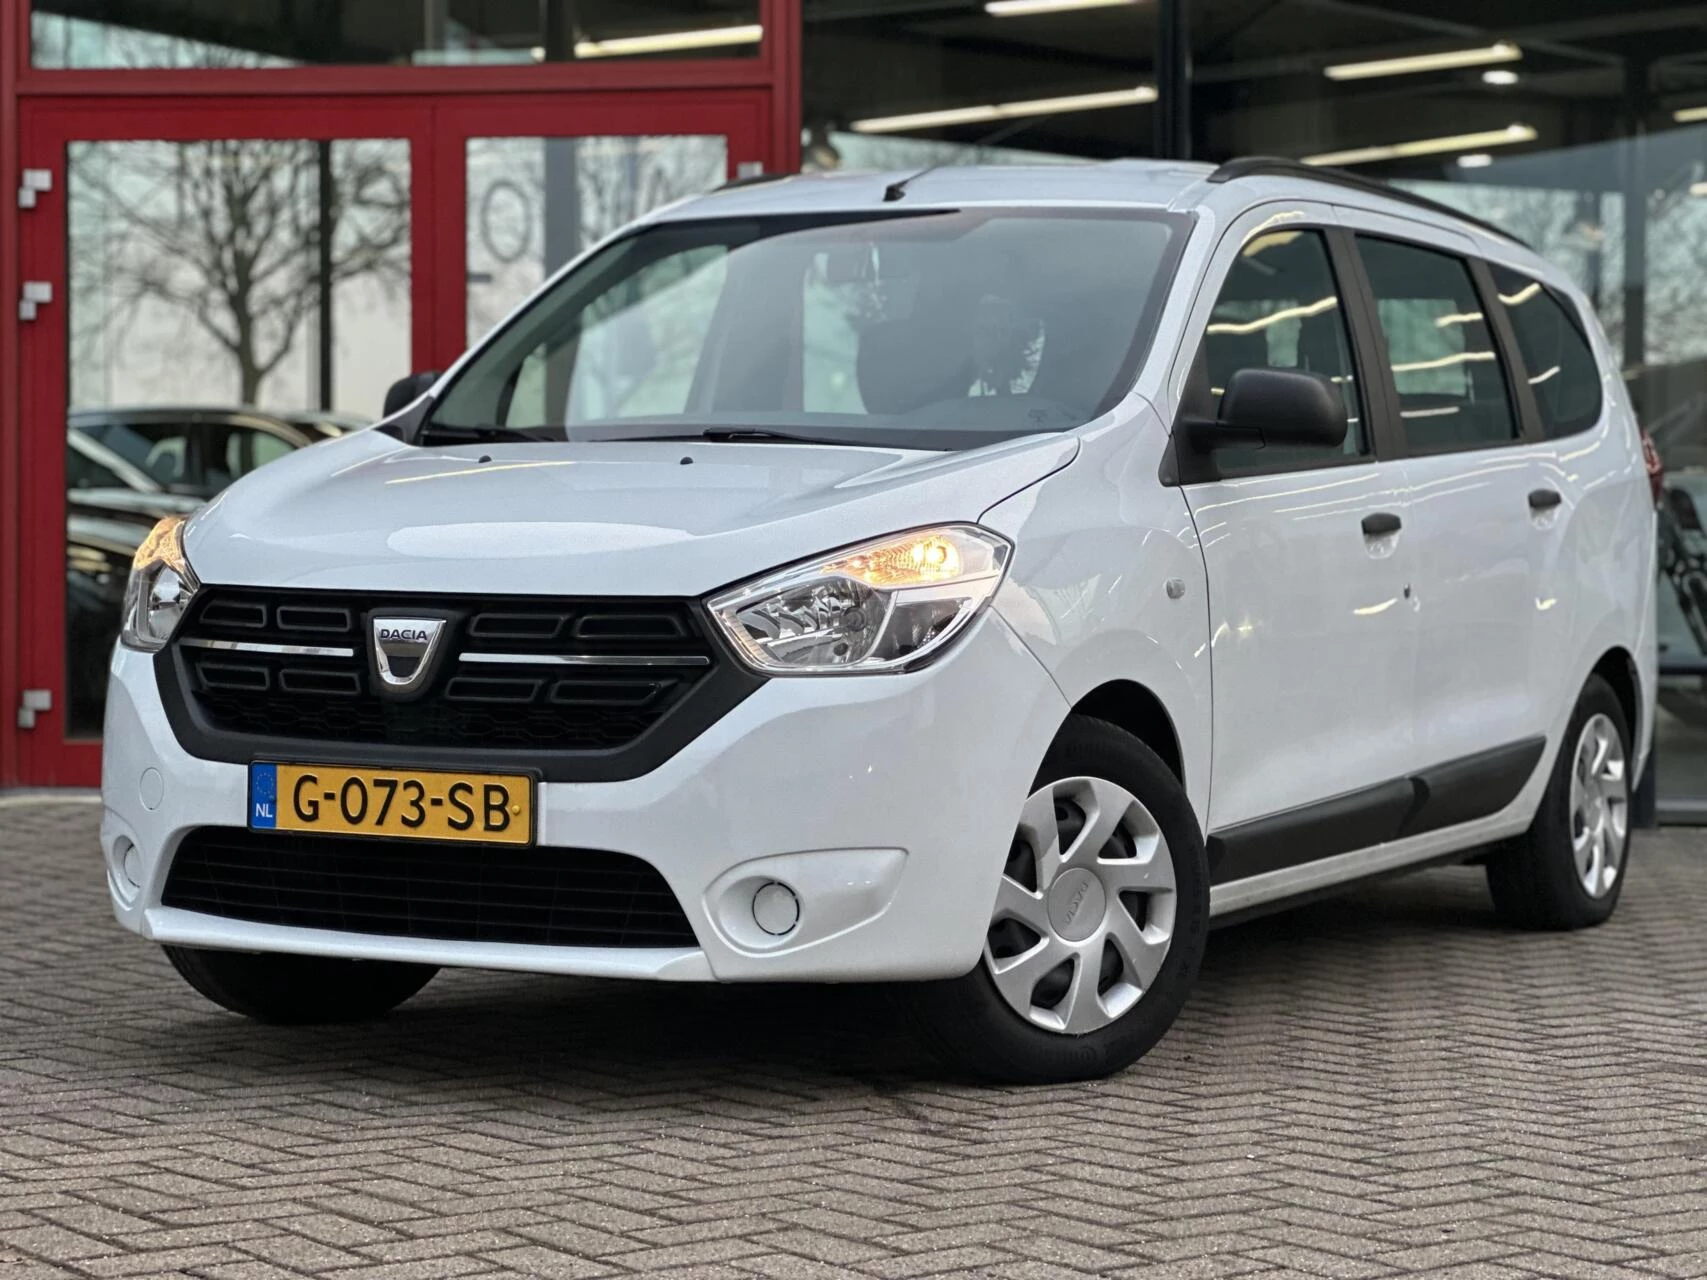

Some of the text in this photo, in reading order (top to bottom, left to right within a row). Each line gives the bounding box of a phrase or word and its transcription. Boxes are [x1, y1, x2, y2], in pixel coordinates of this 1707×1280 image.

[380, 628, 428, 641] DACIA
[255, 802, 273, 818] NL
[292, 774, 511, 832] G-073-SB
